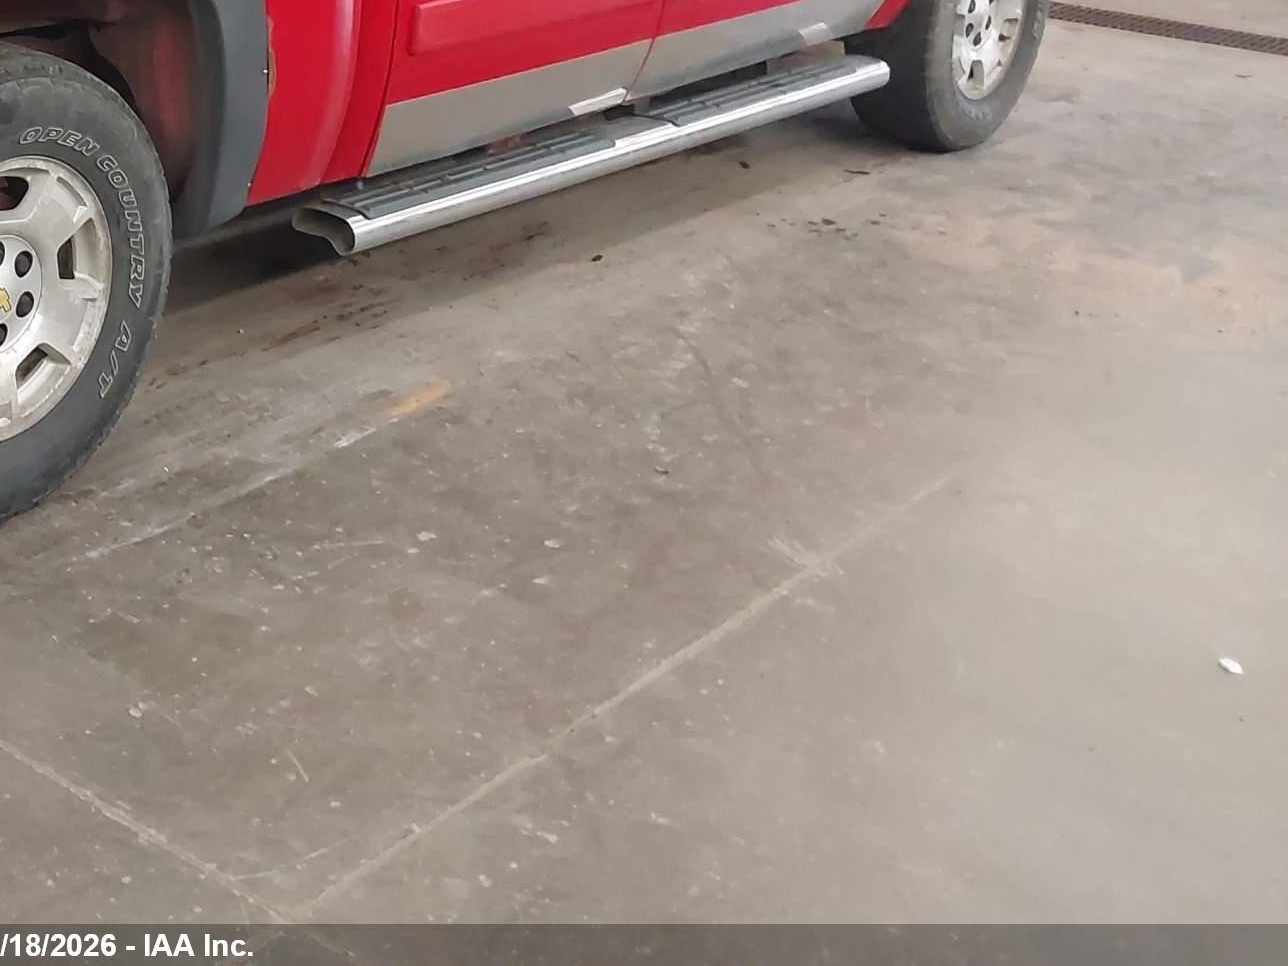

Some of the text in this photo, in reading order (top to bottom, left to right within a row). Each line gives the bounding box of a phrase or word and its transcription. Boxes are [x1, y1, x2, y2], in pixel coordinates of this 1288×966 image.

[19, 126, 145, 399] OPEN COUNTRY A/T
